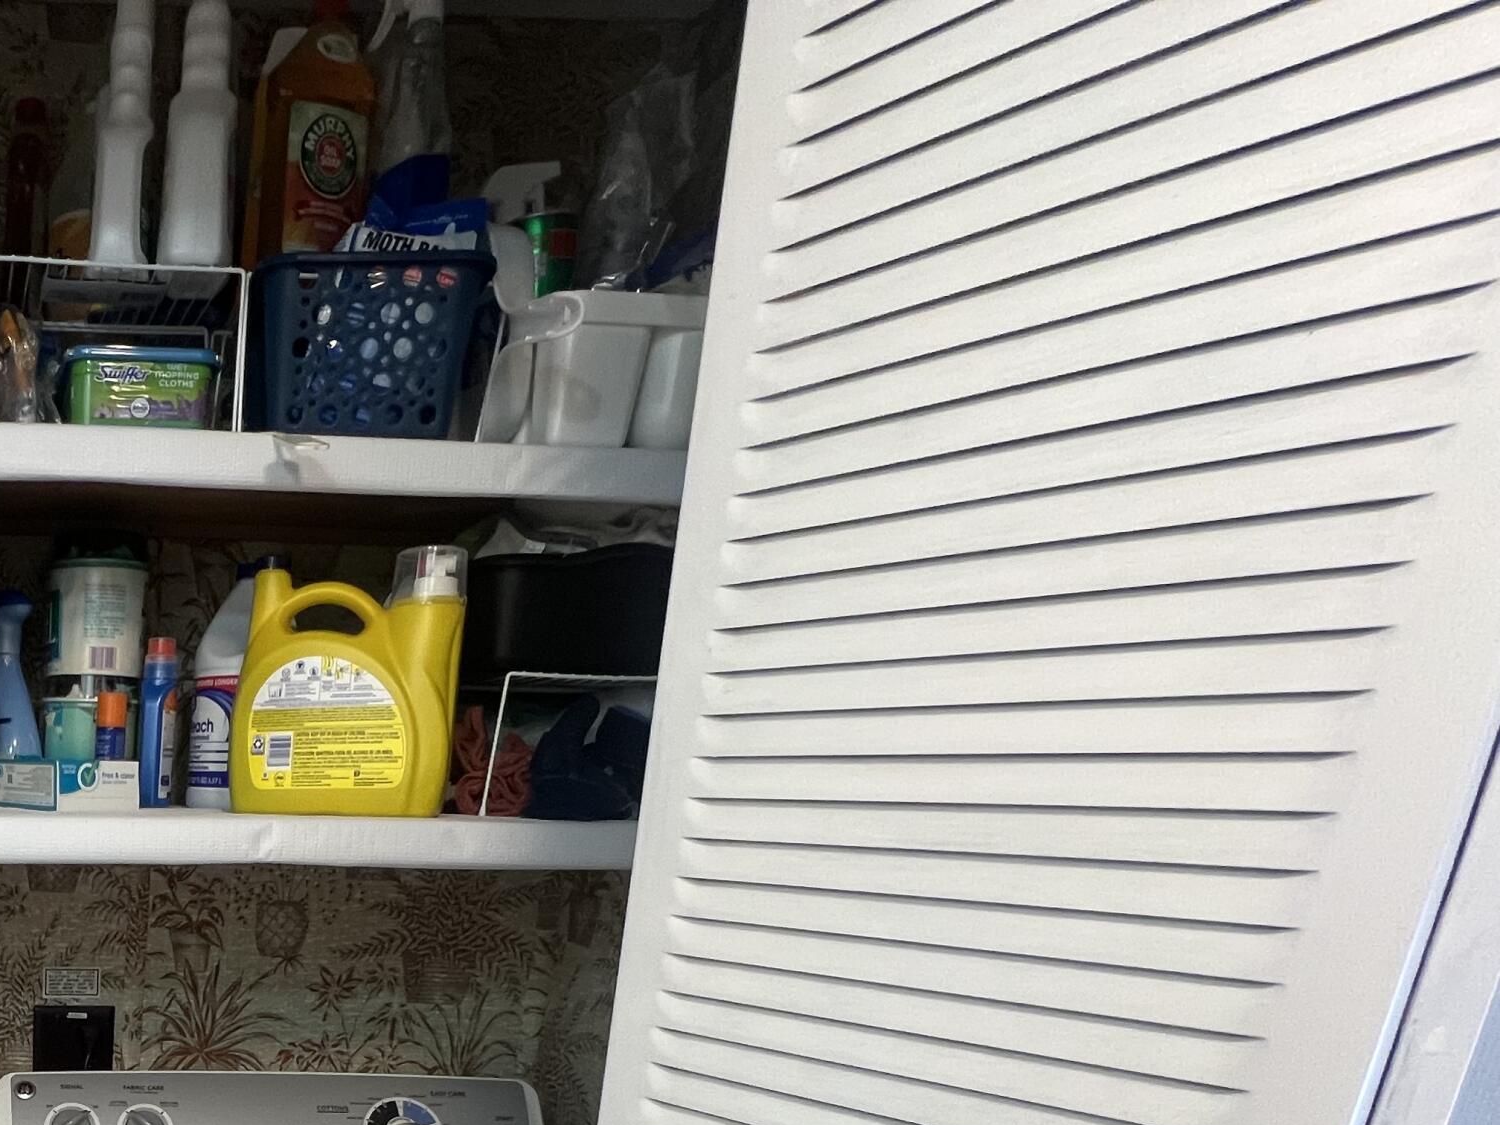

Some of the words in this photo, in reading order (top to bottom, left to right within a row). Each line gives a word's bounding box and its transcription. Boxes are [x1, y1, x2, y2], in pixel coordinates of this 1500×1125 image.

[305, 117, 355, 159] MURPHY
[362, 231, 415, 251] MOTH
[95, 365, 151, 384] Swiffer
[191, 718, 214, 733] each
